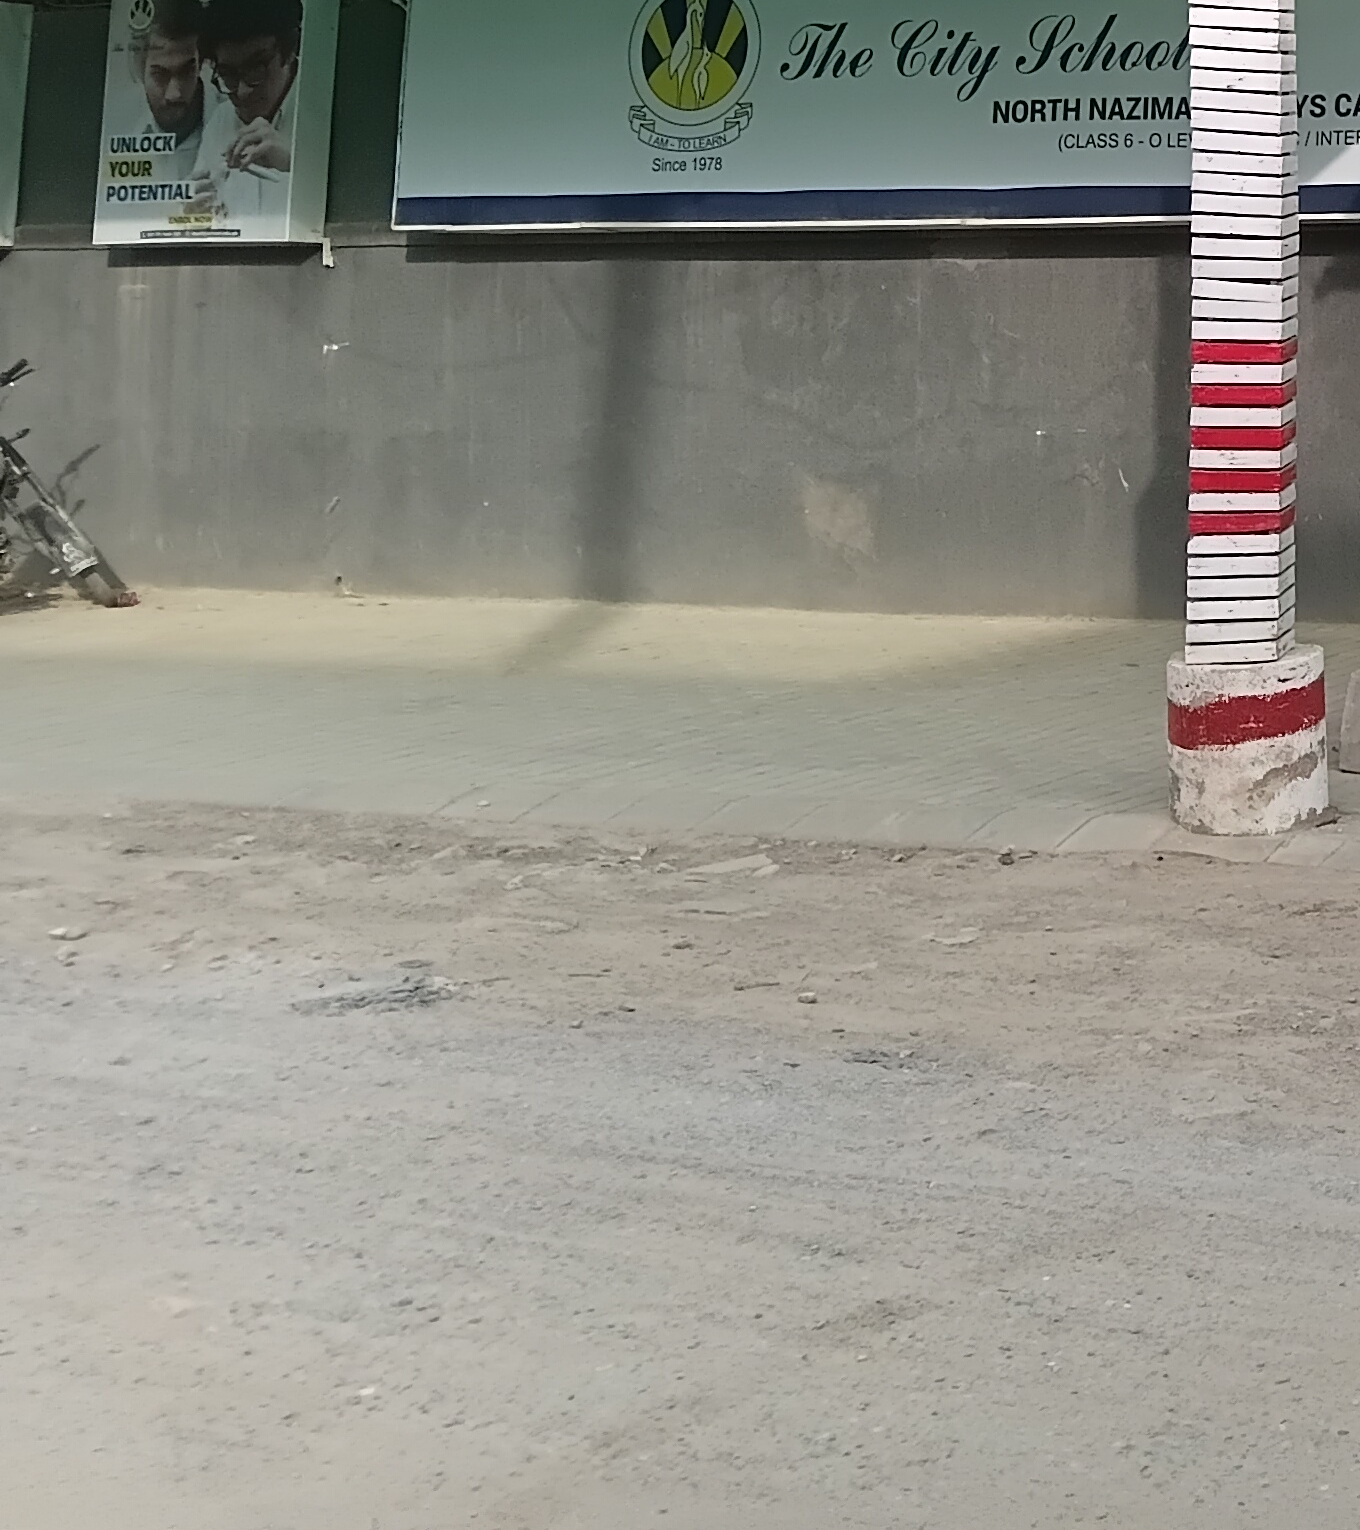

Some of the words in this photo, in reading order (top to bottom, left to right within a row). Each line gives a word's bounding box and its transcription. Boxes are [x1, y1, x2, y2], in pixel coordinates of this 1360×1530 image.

[780, 21, 875, 81] The
[890, 18, 1001, 103] City
[1014, 13, 1191, 75] School
[992, 97, 1081, 124] NORTH
[1089, 95, 1192, 121] NAZIMA
[111, 135, 174, 154] UNLOCK
[653, 136, 669, 148] AM
[677, 138, 691, 150] TO
[692, 133, 727, 150] LEARN
[1058, 132, 1120, 153] (CLASS
[1123, 132, 1134, 149] 6
[108, 159, 153, 179] YOUR
[651, 157, 687, 172] Since
[691, 156, 723, 171] 1978
[106, 183, 193, 202] POTENTIAL
